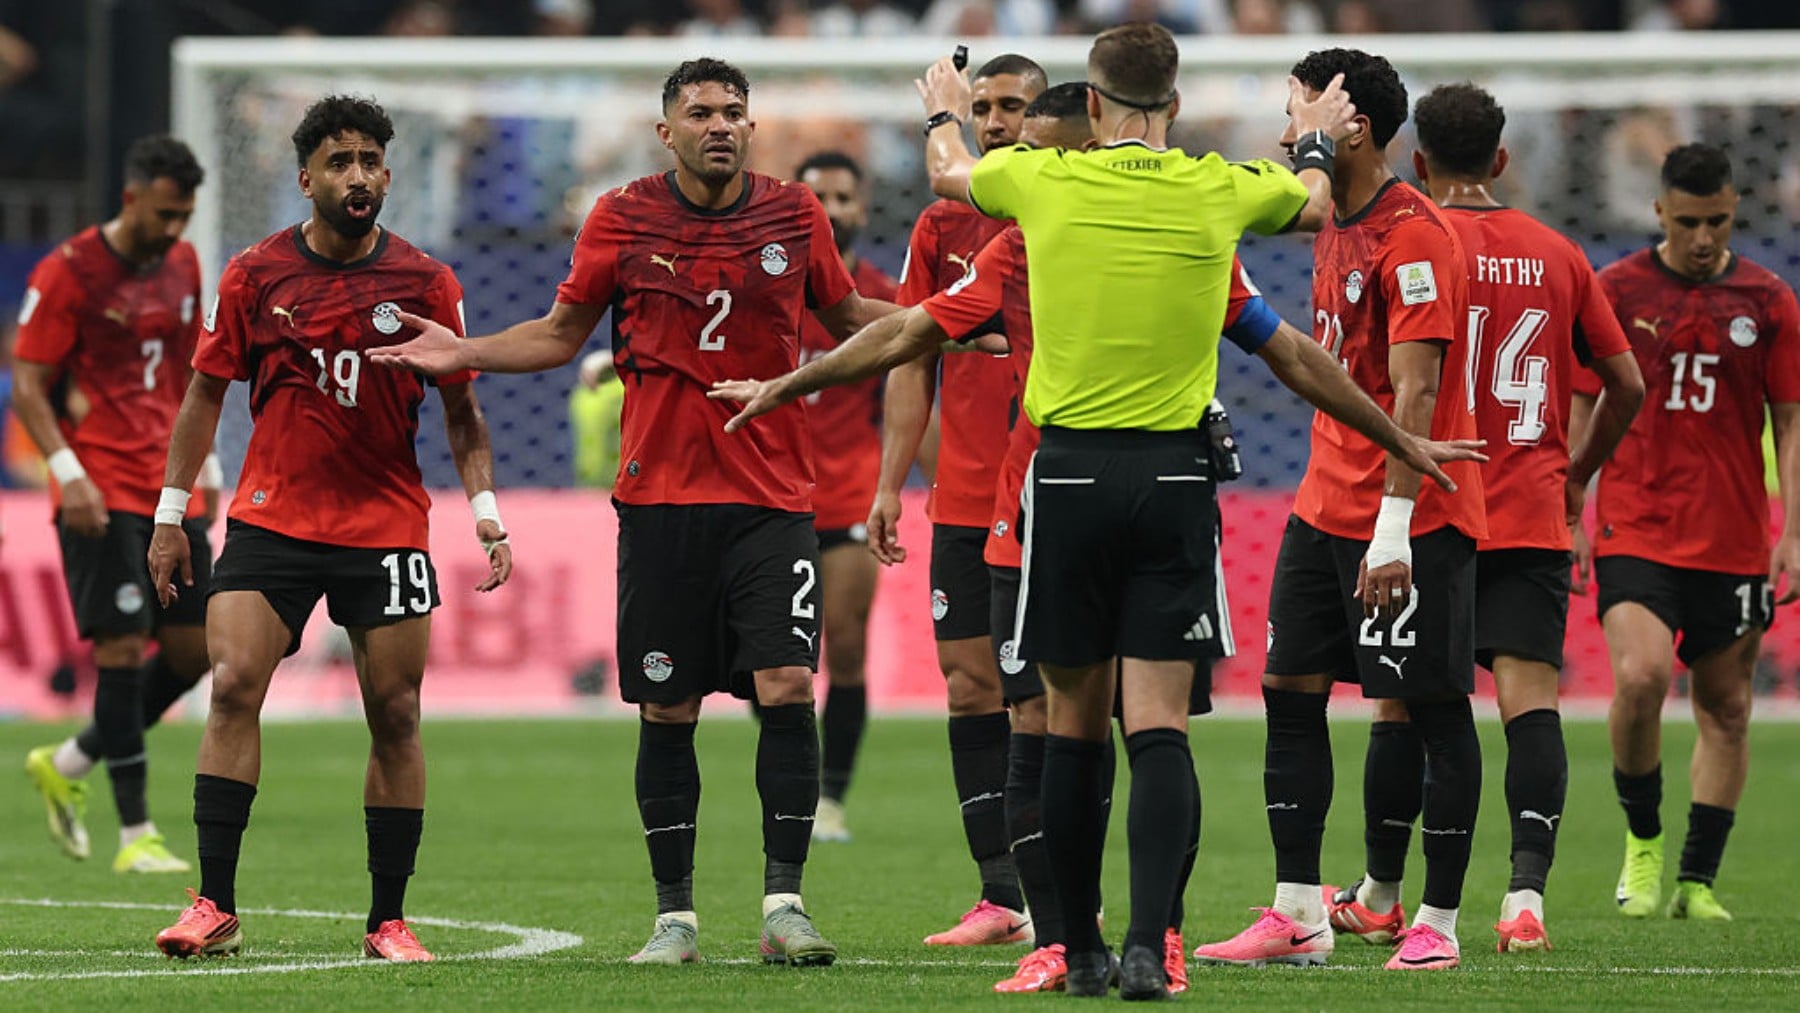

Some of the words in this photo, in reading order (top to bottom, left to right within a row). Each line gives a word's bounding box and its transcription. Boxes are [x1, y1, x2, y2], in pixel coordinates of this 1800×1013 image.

[1476, 254, 1544, 287] FATHY
[699, 289, 732, 351] 2
[141, 338, 163, 391] 7
[310, 348, 361, 407] 19
[1465, 305, 1550, 446] 14
[1664, 352, 1721, 413] 15
[380, 552, 431, 614] 19
[791, 559, 816, 619] 2
